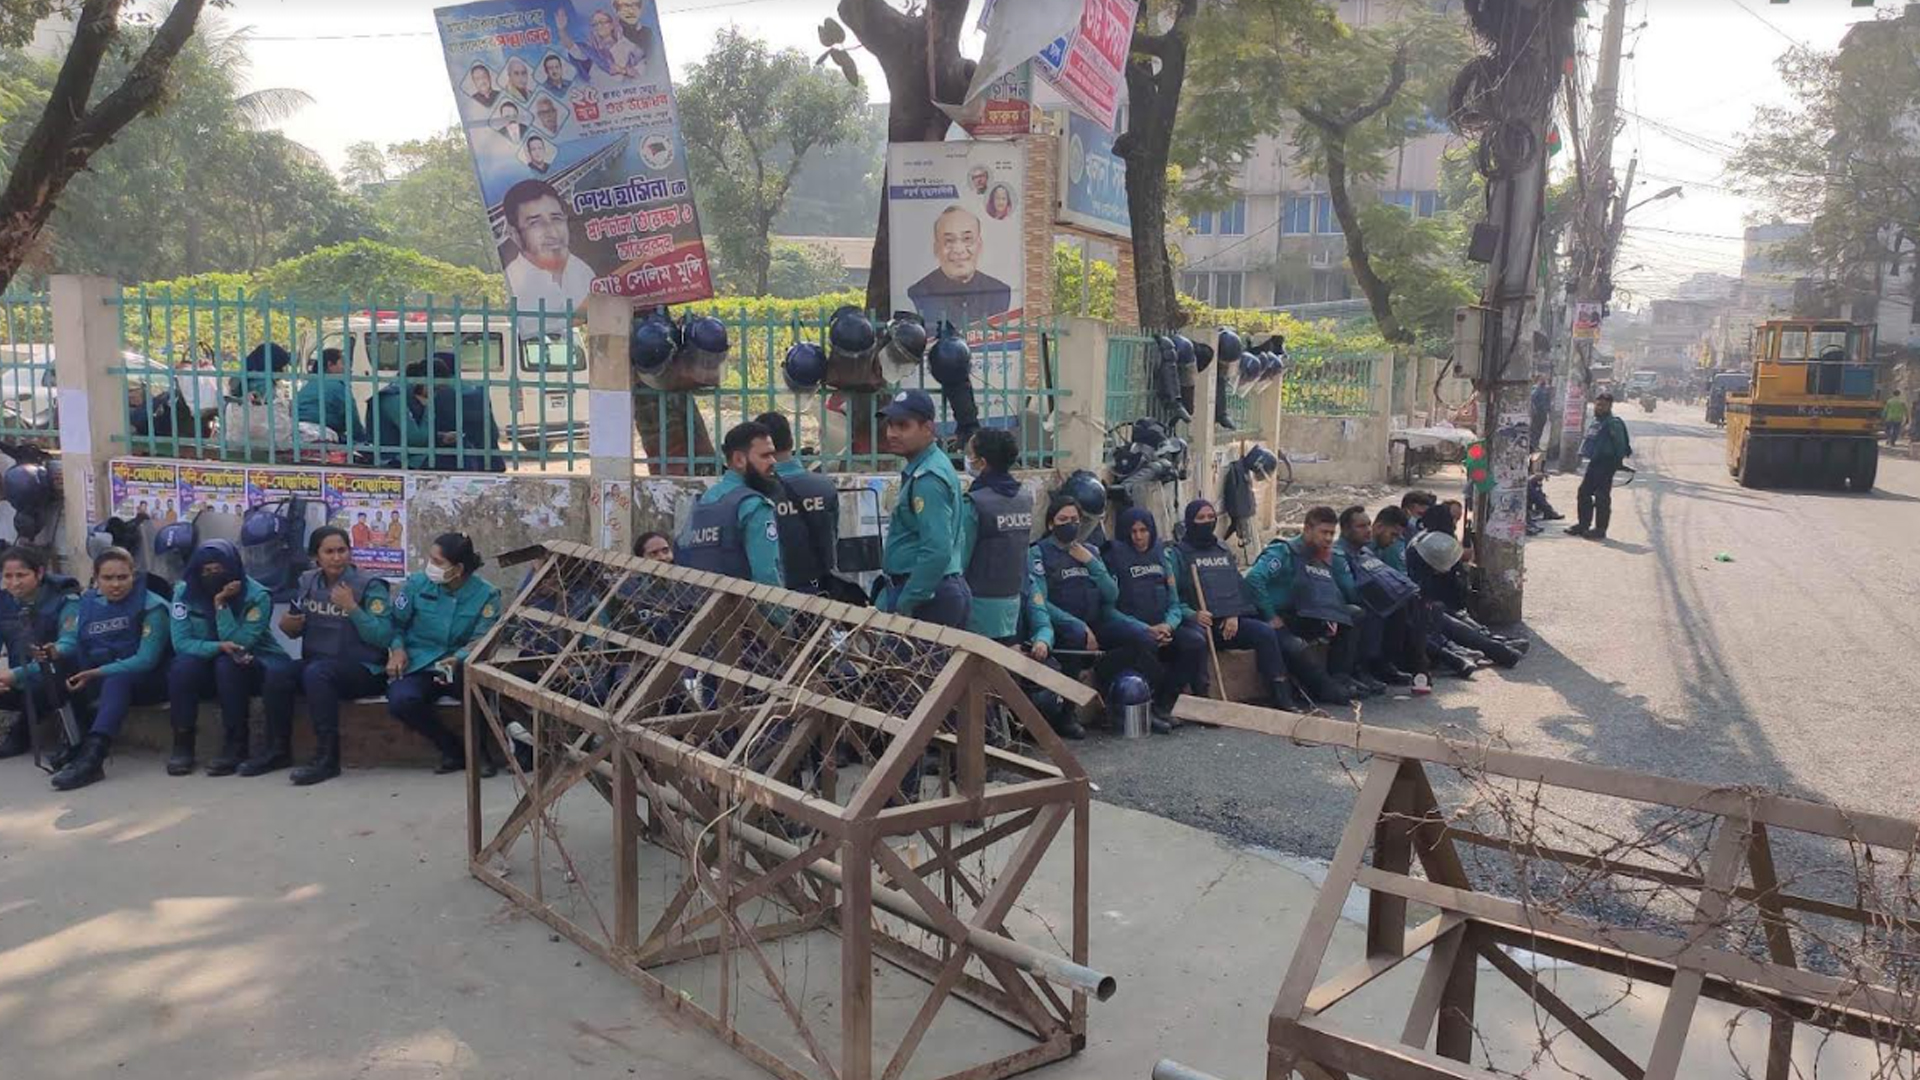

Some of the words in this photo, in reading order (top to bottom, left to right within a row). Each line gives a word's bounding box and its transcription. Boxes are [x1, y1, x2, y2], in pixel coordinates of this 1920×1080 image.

[573, 187, 613, 214] শেখ
[613, 176, 668, 207] হাসিনা
[626, 262, 672, 290] সেলিম
[777, 497, 824, 516] OLCE
[997, 513, 1032, 528] POLICE
[692, 527, 719, 543] OLICE
[1196, 556, 1229, 567] POLICE
[1305, 565, 1332, 579] POLICE
